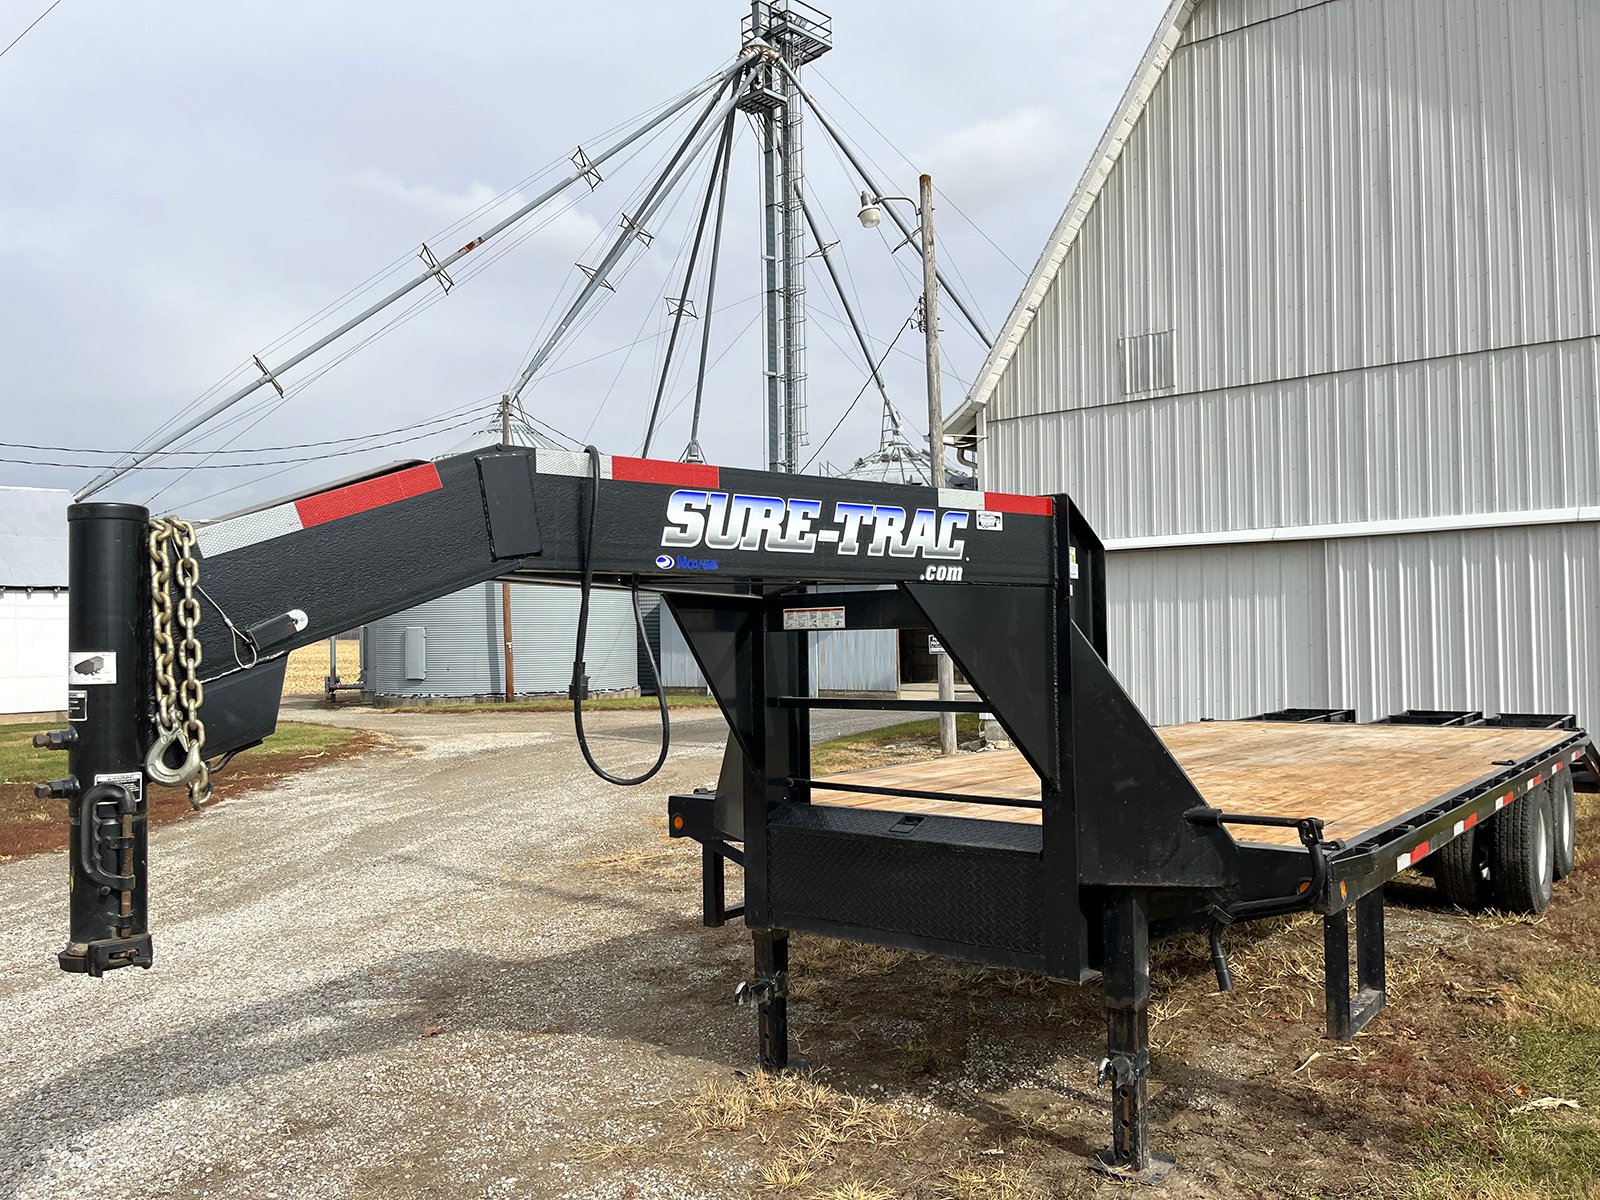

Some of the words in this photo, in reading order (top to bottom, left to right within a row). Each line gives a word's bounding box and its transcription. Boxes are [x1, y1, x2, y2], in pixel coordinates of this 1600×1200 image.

[661, 489, 969, 559] SURE-TRAC
[677, 555, 719, 570] Novae
[919, 565, 963, 581] .com
